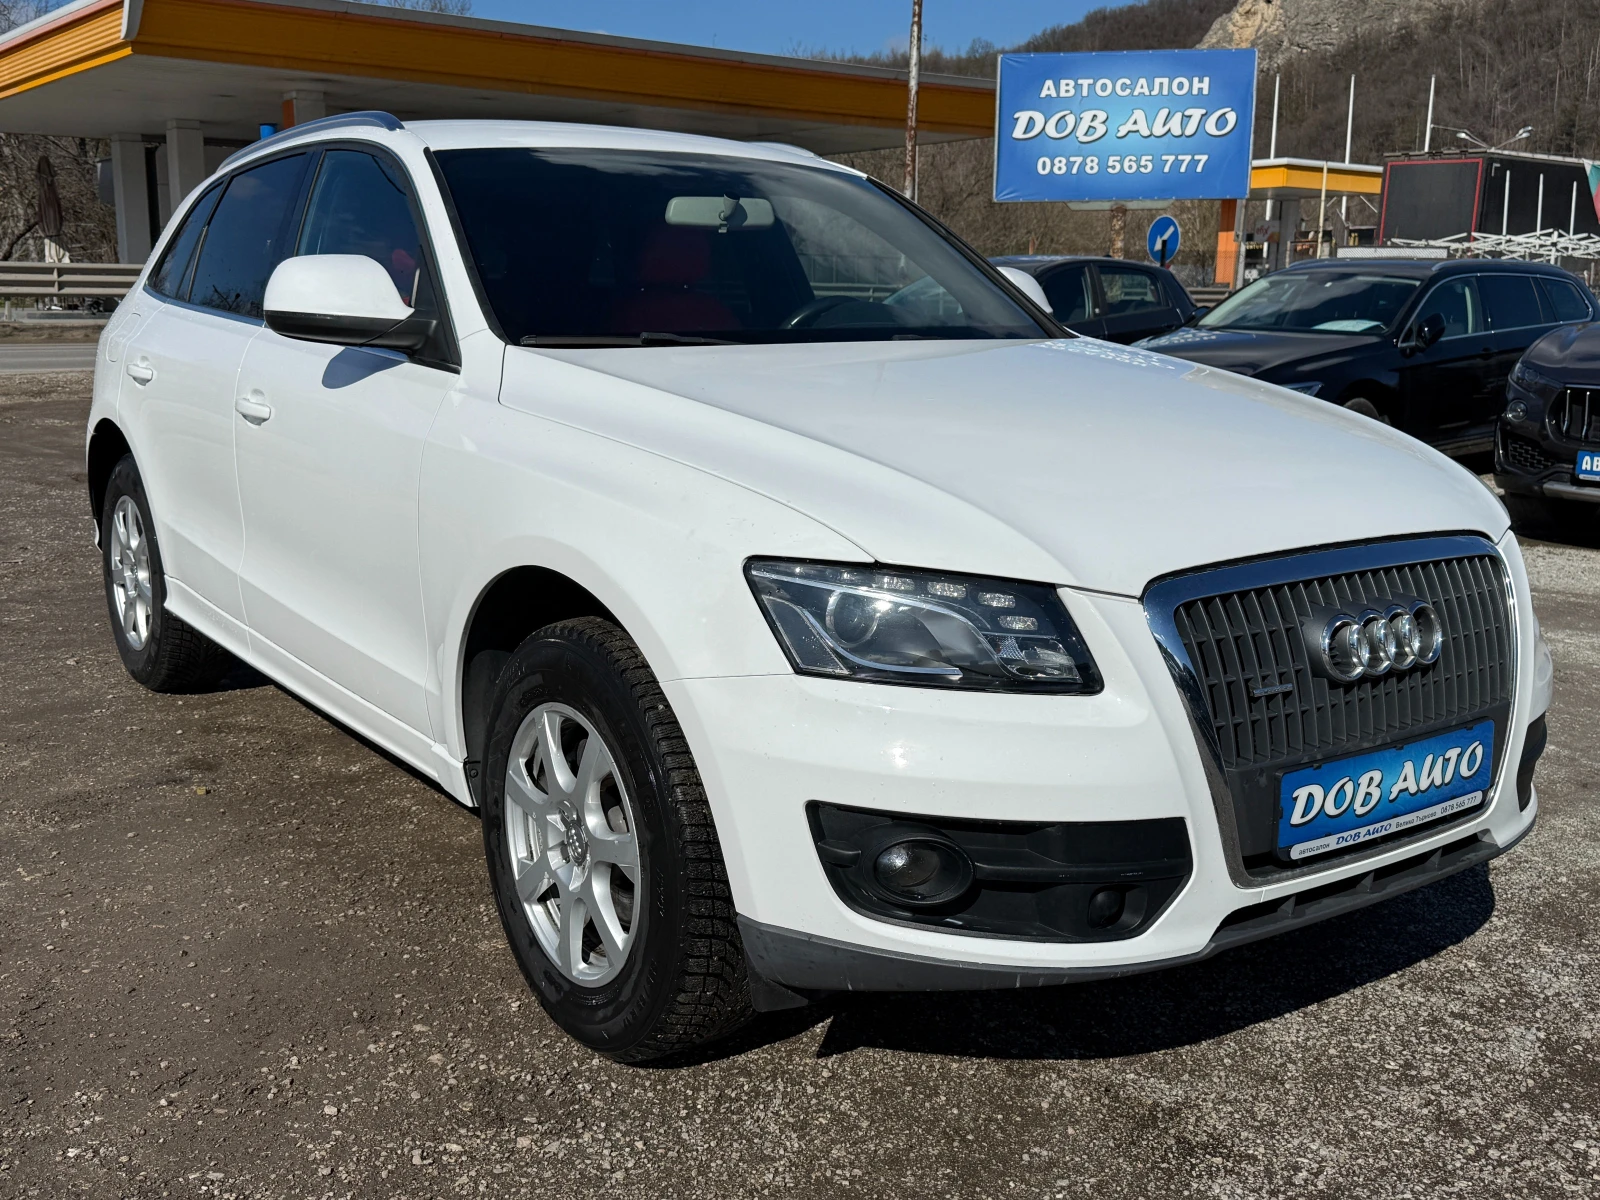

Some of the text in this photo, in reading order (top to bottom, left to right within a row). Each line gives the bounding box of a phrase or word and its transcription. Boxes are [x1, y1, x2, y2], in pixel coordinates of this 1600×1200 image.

[1039, 76, 1210, 98] АВТОСАЛОН
[1011, 106, 1238, 143] DOB AUTO
[1036, 154, 1209, 175] 0878 565 777
[1289, 740, 1484, 828] DOB AUTO
[1298, 842, 1330, 856] автосалон
[1335, 831, 1361, 846] DOB
[1363, 822, 1392, 839] AUTO
[1440, 803, 1455, 815] 0878
[1455, 799, 1466, 810] 565
[1466, 795, 1477, 806] 777
